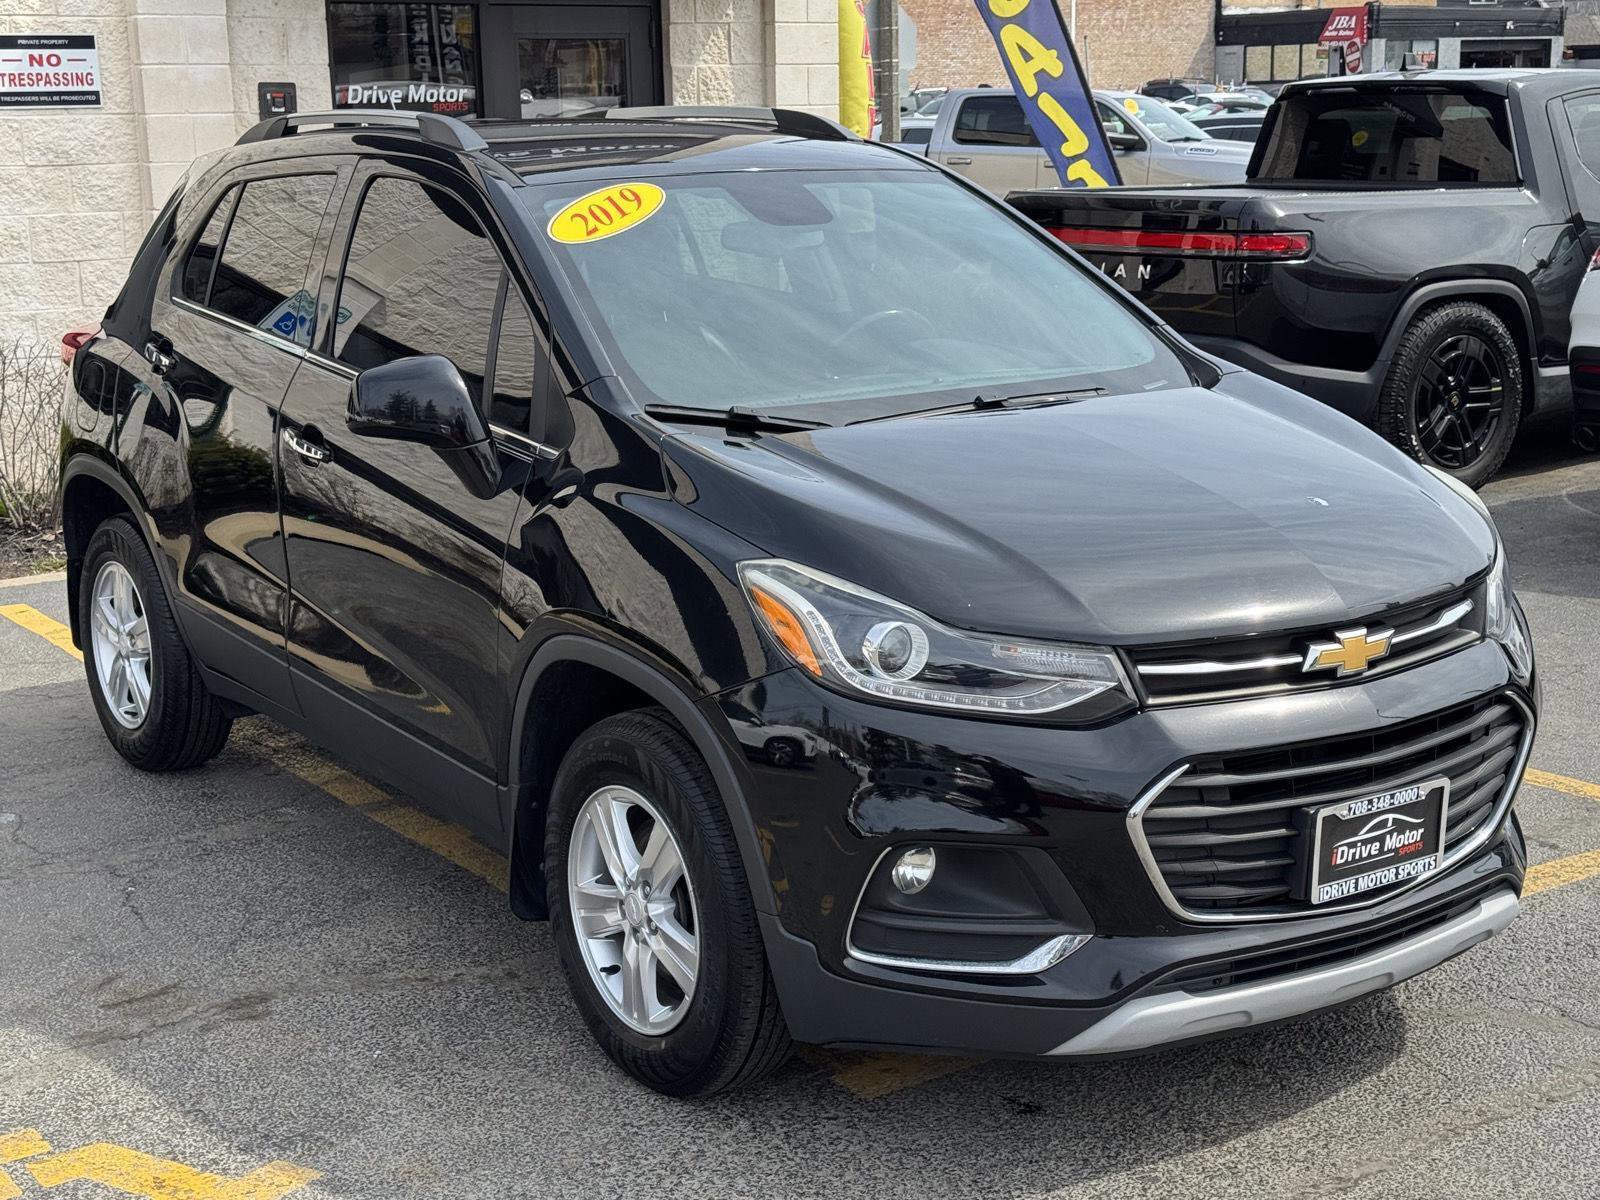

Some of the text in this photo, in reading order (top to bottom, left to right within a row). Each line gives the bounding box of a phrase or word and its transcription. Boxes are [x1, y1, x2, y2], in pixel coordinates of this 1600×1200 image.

[1328, 15, 1356, 30] JBA
[28, 53, 62, 67] NO
[0, 72, 95, 87] TRESPASSING
[408, 84, 469, 103] Motor
[432, 102, 469, 112] SPORTS
[571, 187, 642, 237] 2019
[1100, 262, 1151, 280] IAN
[1349, 787, 1418, 815] 708-348-0000
[1331, 828, 1425, 866] iDrive Motor
[1399, 841, 1424, 857] SPORTS
[1358, 870, 1396, 890] MOTOR
[1397, 856, 1436, 878] SPORTS
